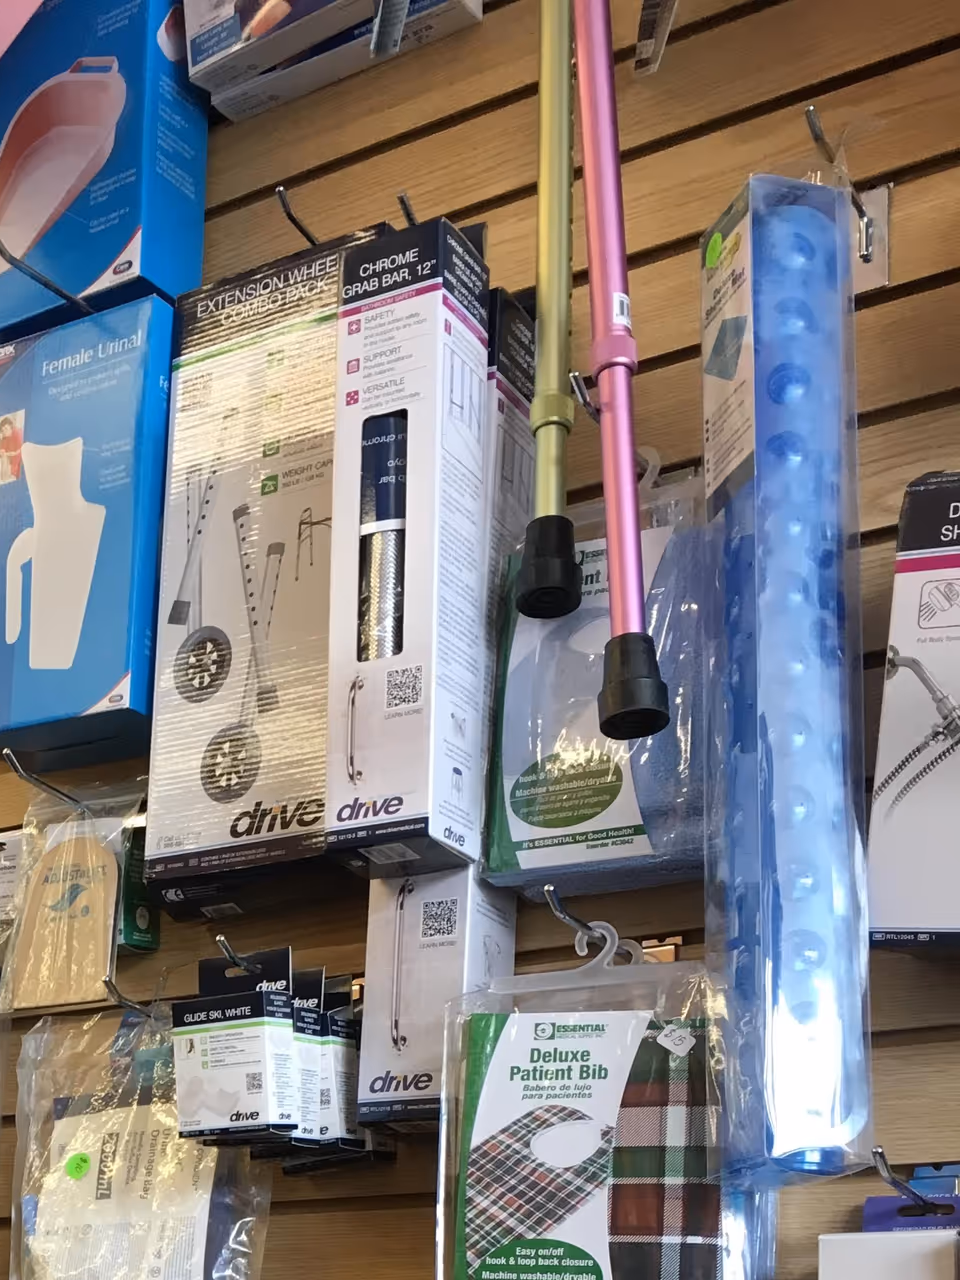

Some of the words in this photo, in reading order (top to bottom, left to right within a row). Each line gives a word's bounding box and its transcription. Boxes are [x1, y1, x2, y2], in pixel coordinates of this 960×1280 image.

[359, 248, 420, 277] CHROME
[196, 273, 284, 318] EXTENSION
[289, 255, 338, 284] WHEE
[342, 279, 379, 299] GRAB
[382, 268, 412, 286] BAR,
[220, 289, 281, 325] COMBO
[286, 276, 330, 302] PACK
[360, 295, 394, 312] BATHROOM
[394, 289, 417, 303] SAFETY
[364, 308, 396, 324] SAFETY
[42, 348, 94, 377] Female
[98, 329, 143, 359] Urinal
[363, 345, 403, 364] SUPPORT
[362, 376, 406, 395] VERSATILE
[281, 462, 312, 479] WEIGHT
[515, 785, 547, 797] Machine
[230, 798, 327, 840] drive
[337, 796, 404, 823] drive
[444, 824, 466, 847] drive
[534, 835, 575, 848] ESSENTIAL
[575, 833, 587, 842] for
[587, 831, 607, 840] Good
[608, 827, 635, 837] Health!
[256, 979, 288, 992] drive
[183, 1010, 208, 1024] GLIDE
[208, 1008, 224, 1022] SKI,
[225, 1005, 252, 1018] WHITE
[556, 1023, 607, 1033] ESSENTIAL
[530, 1046, 591, 1064] Deluxe
[509, 1064, 574, 1082] Patient
[578, 1063, 609, 1081] Bib
[369, 1070, 433, 1095] drive
[522, 1083, 557, 1092] Babero
[559, 1083, 572, 1092] de
[573, 1083, 592, 1093] lujo
[521, 1092, 544, 1101] para
[544, 1090, 593, 1101] pacientes
[230, 1110, 260, 1123] drive
[278, 1112, 292, 1121] drive
[301, 1126, 314, 1136] drive
[144, 1129, 161, 1178] Drainage
[139, 1179, 153, 1200] Bag
[485, 1256, 507, 1265] hook
[508, 1256, 516, 1265] &
[517, 1257, 537, 1267] loop
[537, 1257, 560, 1266] back
[561, 1258, 594, 1267] closure
[515, 1247, 537, 1257] Easy
[537, 1247, 565, 1257] on/off
[481, 1270, 518, 1280] Machine
